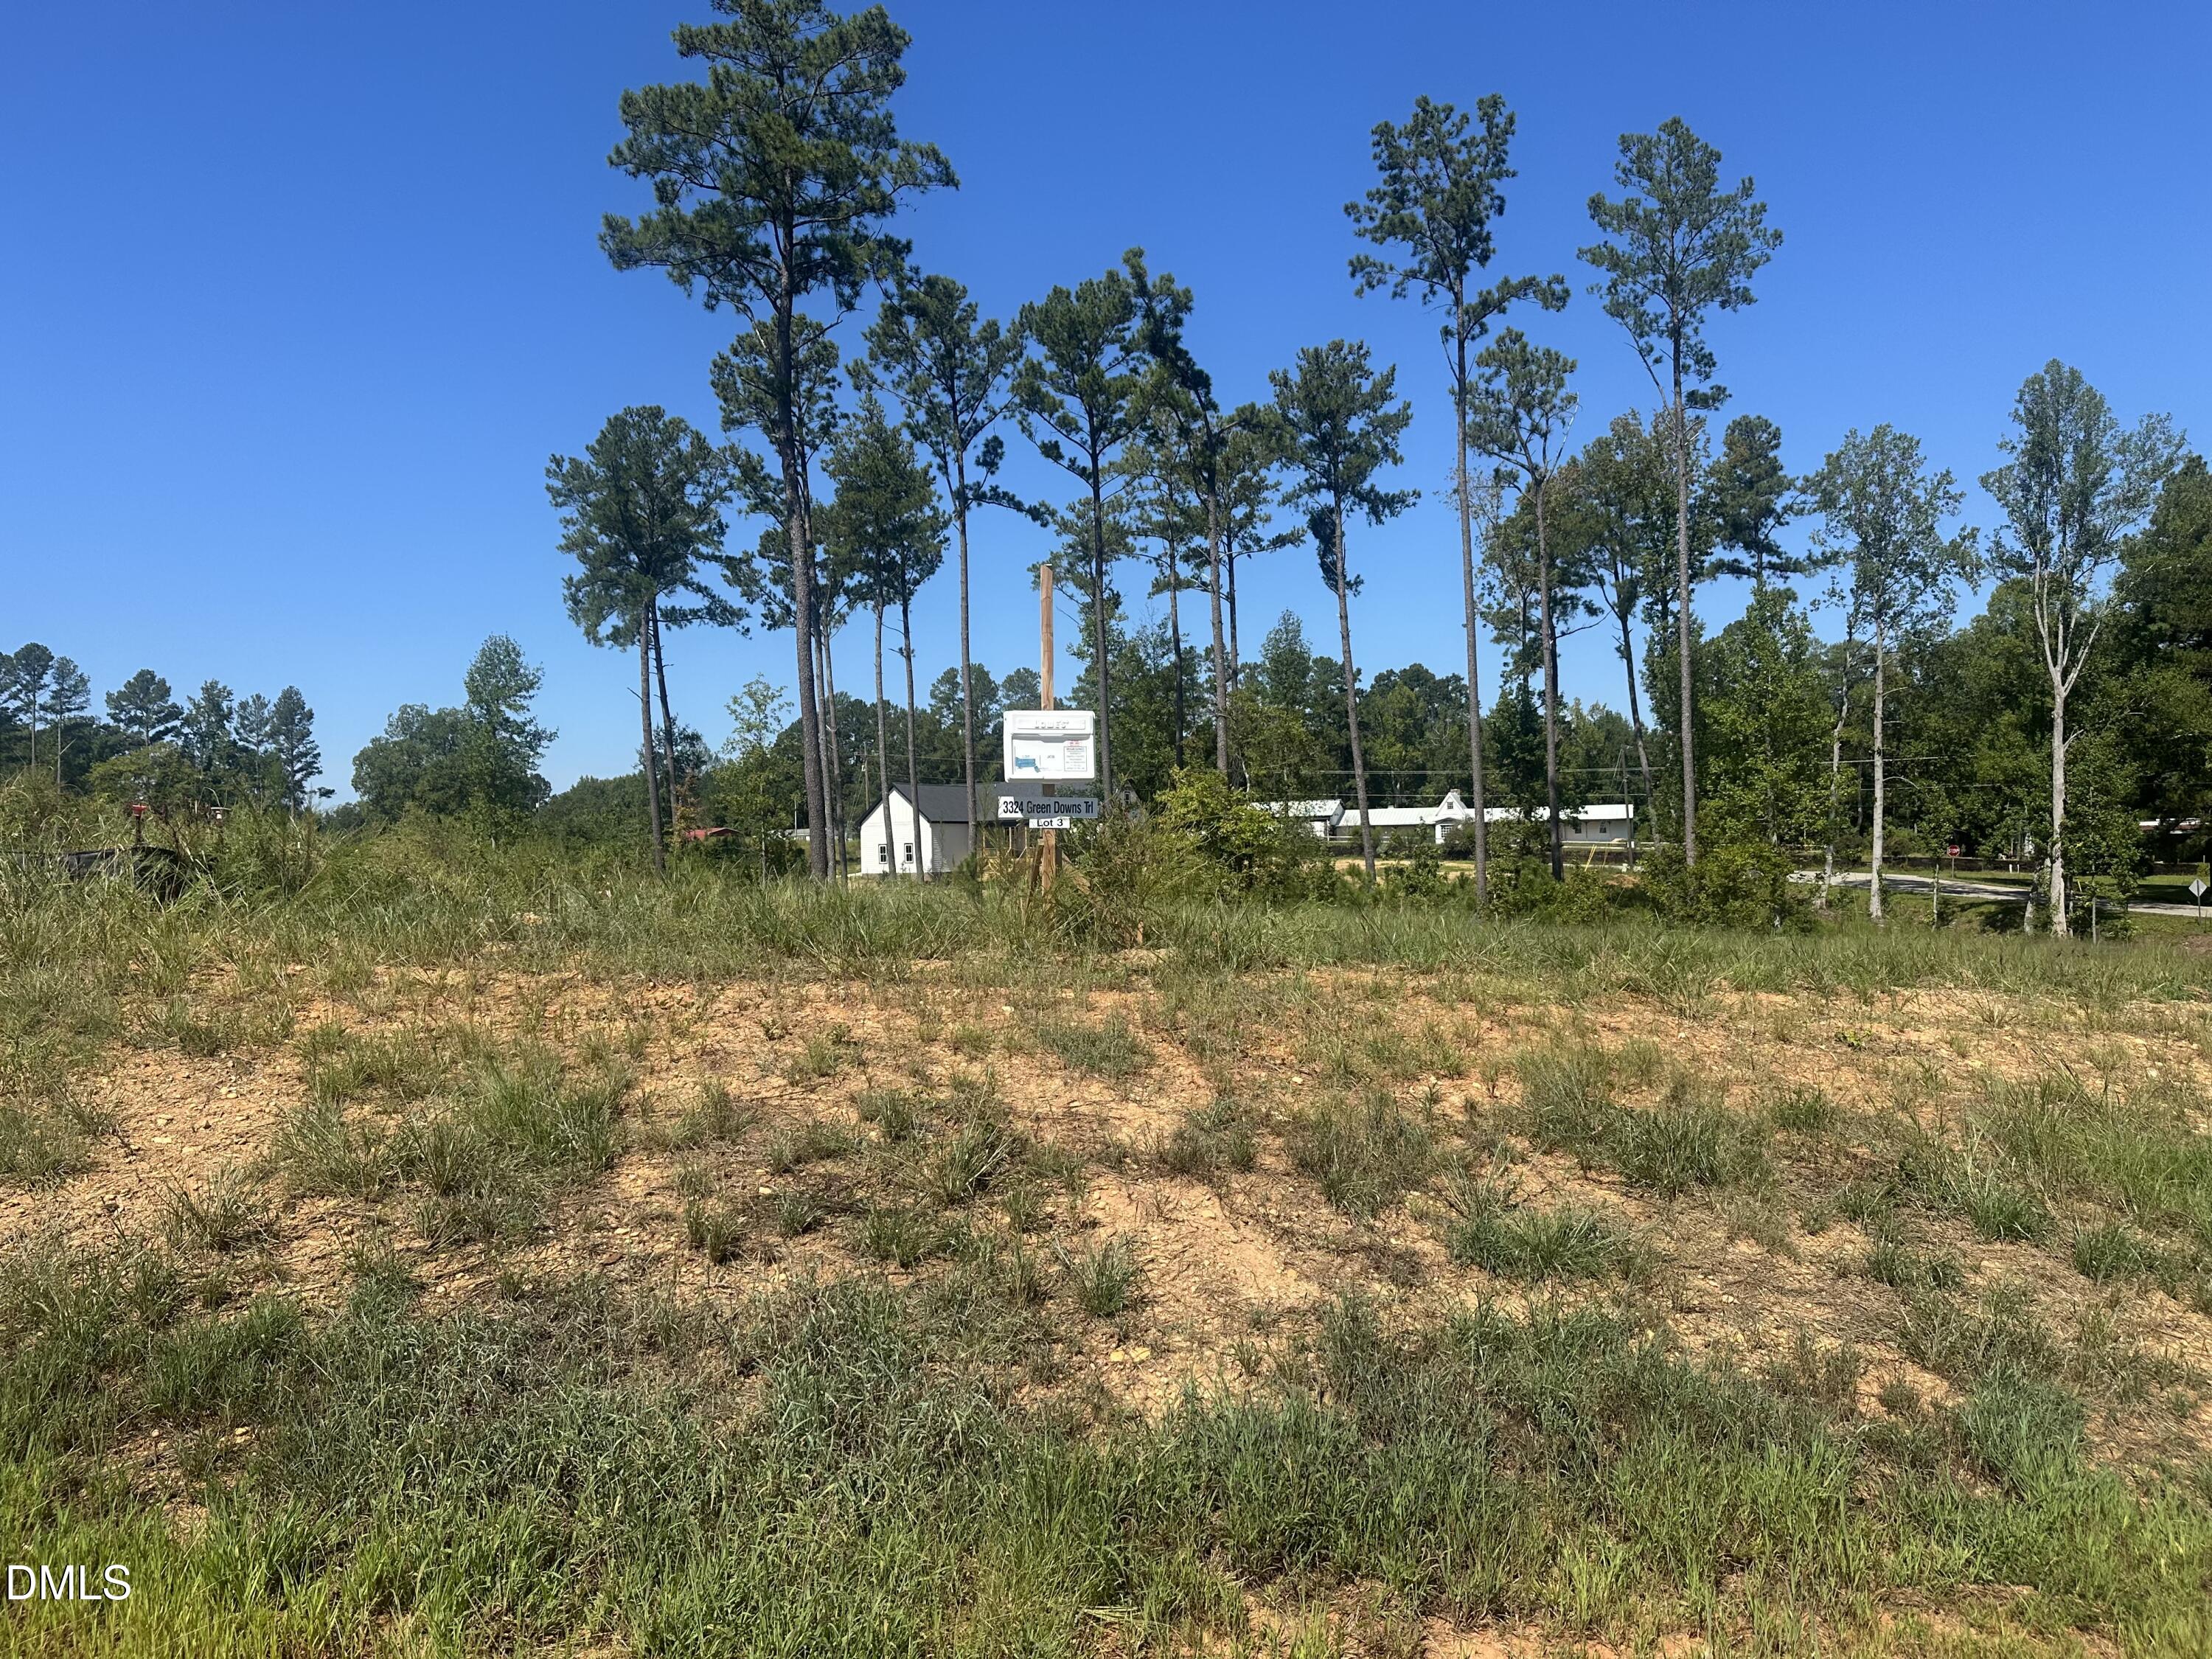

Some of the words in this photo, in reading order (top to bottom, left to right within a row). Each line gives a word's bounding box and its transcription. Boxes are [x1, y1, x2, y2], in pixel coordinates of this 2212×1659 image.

[1003, 801, 1023, 814] 3324
[1027, 801, 1051, 814] Green
[1054, 801, 1082, 814] Downs
[1084, 801, 1093, 814] Trl
[1057, 818, 1063, 827] 3
